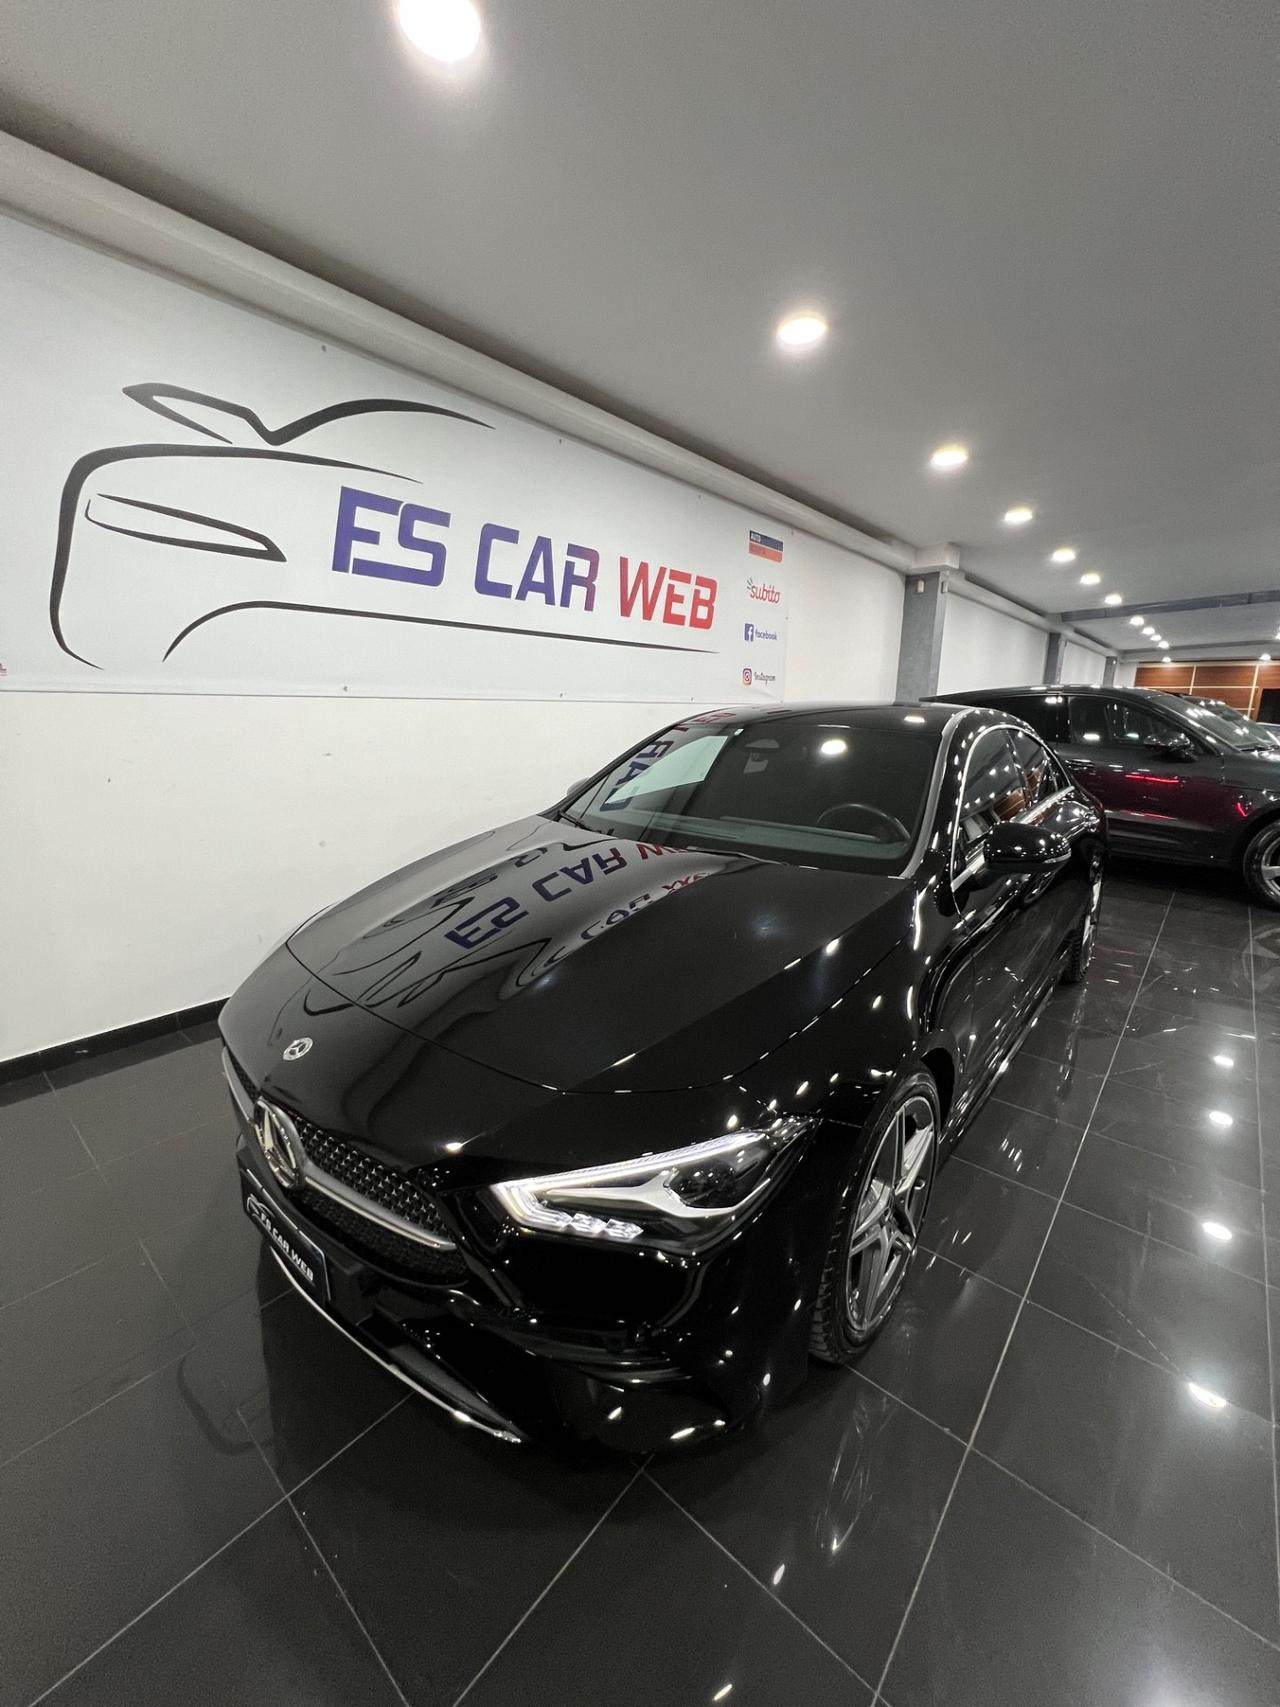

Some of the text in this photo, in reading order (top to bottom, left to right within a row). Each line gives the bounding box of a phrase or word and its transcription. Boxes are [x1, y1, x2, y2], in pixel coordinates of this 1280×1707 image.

[332, 486, 718, 630] ES CAR WEB
[749, 583, 781, 605] subito
[755, 628, 777, 641] facebook
[272, 1228, 290, 1253] CAR
[291, 1249, 314, 1281] WEB
